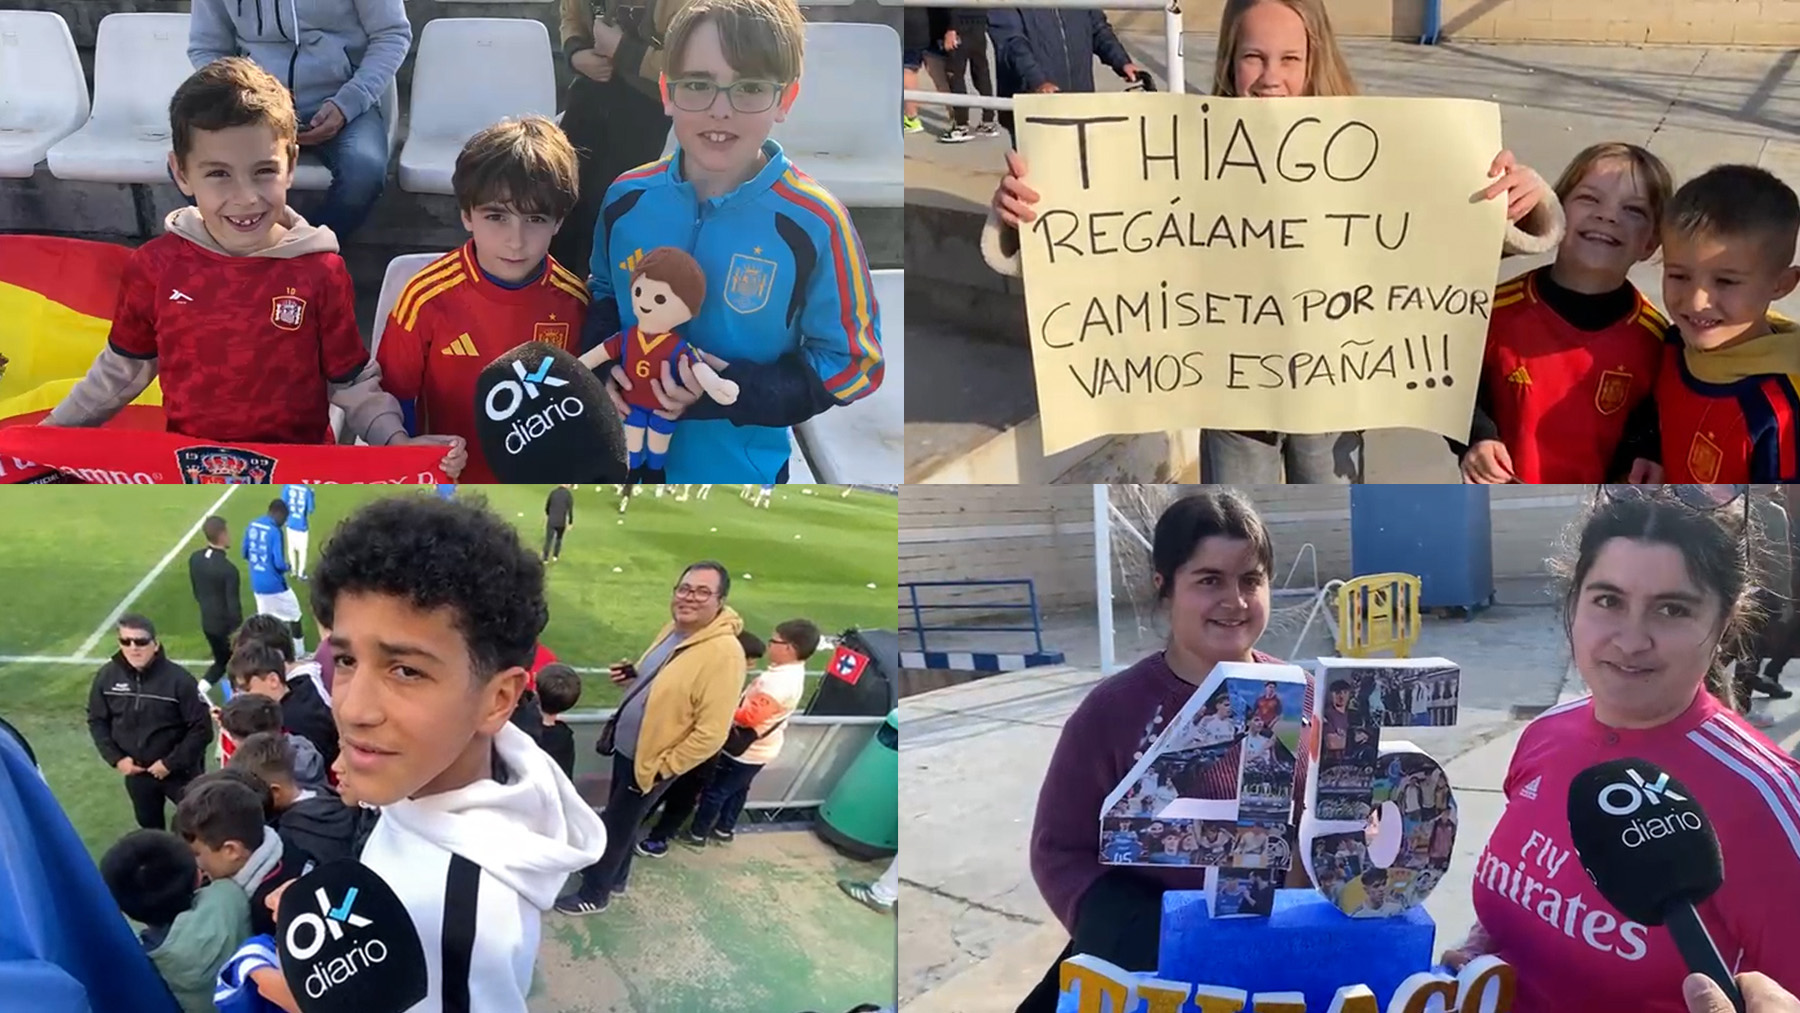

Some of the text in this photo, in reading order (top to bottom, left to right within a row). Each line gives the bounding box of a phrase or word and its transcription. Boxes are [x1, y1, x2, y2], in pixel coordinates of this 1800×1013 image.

[1032, 196, 1409, 263] REGÁLAME TU
[1291, 285, 1375, 323] POR
[1387, 284, 1489, 320] FAVOR
[635, 360, 651, 377] 6
[1068, 351, 1204, 398] VAMOS
[505, 397, 584, 455] diario
[1621, 808, 1702, 849] diario
[1520, 829, 1570, 879] Fly
[305, 940, 388, 999] diario
